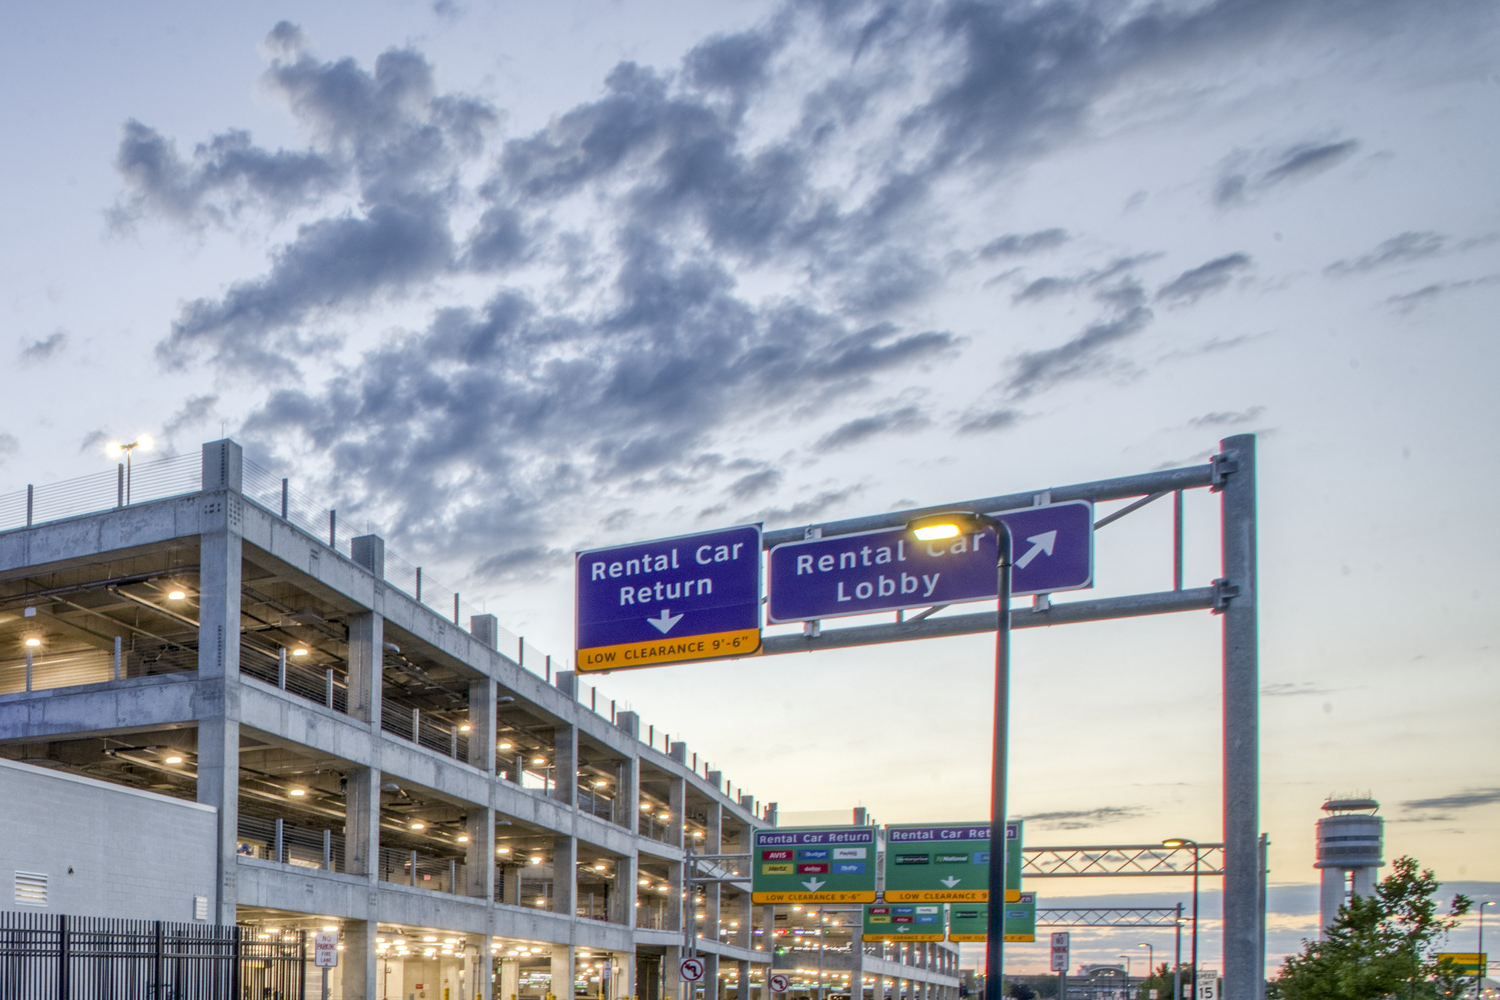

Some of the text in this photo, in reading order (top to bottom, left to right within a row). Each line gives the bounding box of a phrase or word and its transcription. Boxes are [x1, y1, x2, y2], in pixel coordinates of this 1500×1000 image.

[796, 531, 986, 575] Rental Car
[591, 542, 744, 582] Rental Car
[619, 577, 713, 606] Return
[836, 571, 941, 602] Lobby
[587, 651, 617, 665] LOW
[624, 641, 705, 660] CLEARANCE
[759, 832, 870, 844] Rental Car Return
[892, 828, 1014, 840] Rental Car Retn
[768, 851, 787, 859] AVIS
[942, 855, 969, 863] National
[788, 893, 836, 901] CLEARANCE
[924, 892, 977, 900] CLEARANCE
[1199, 987, 1213, 999] 15
